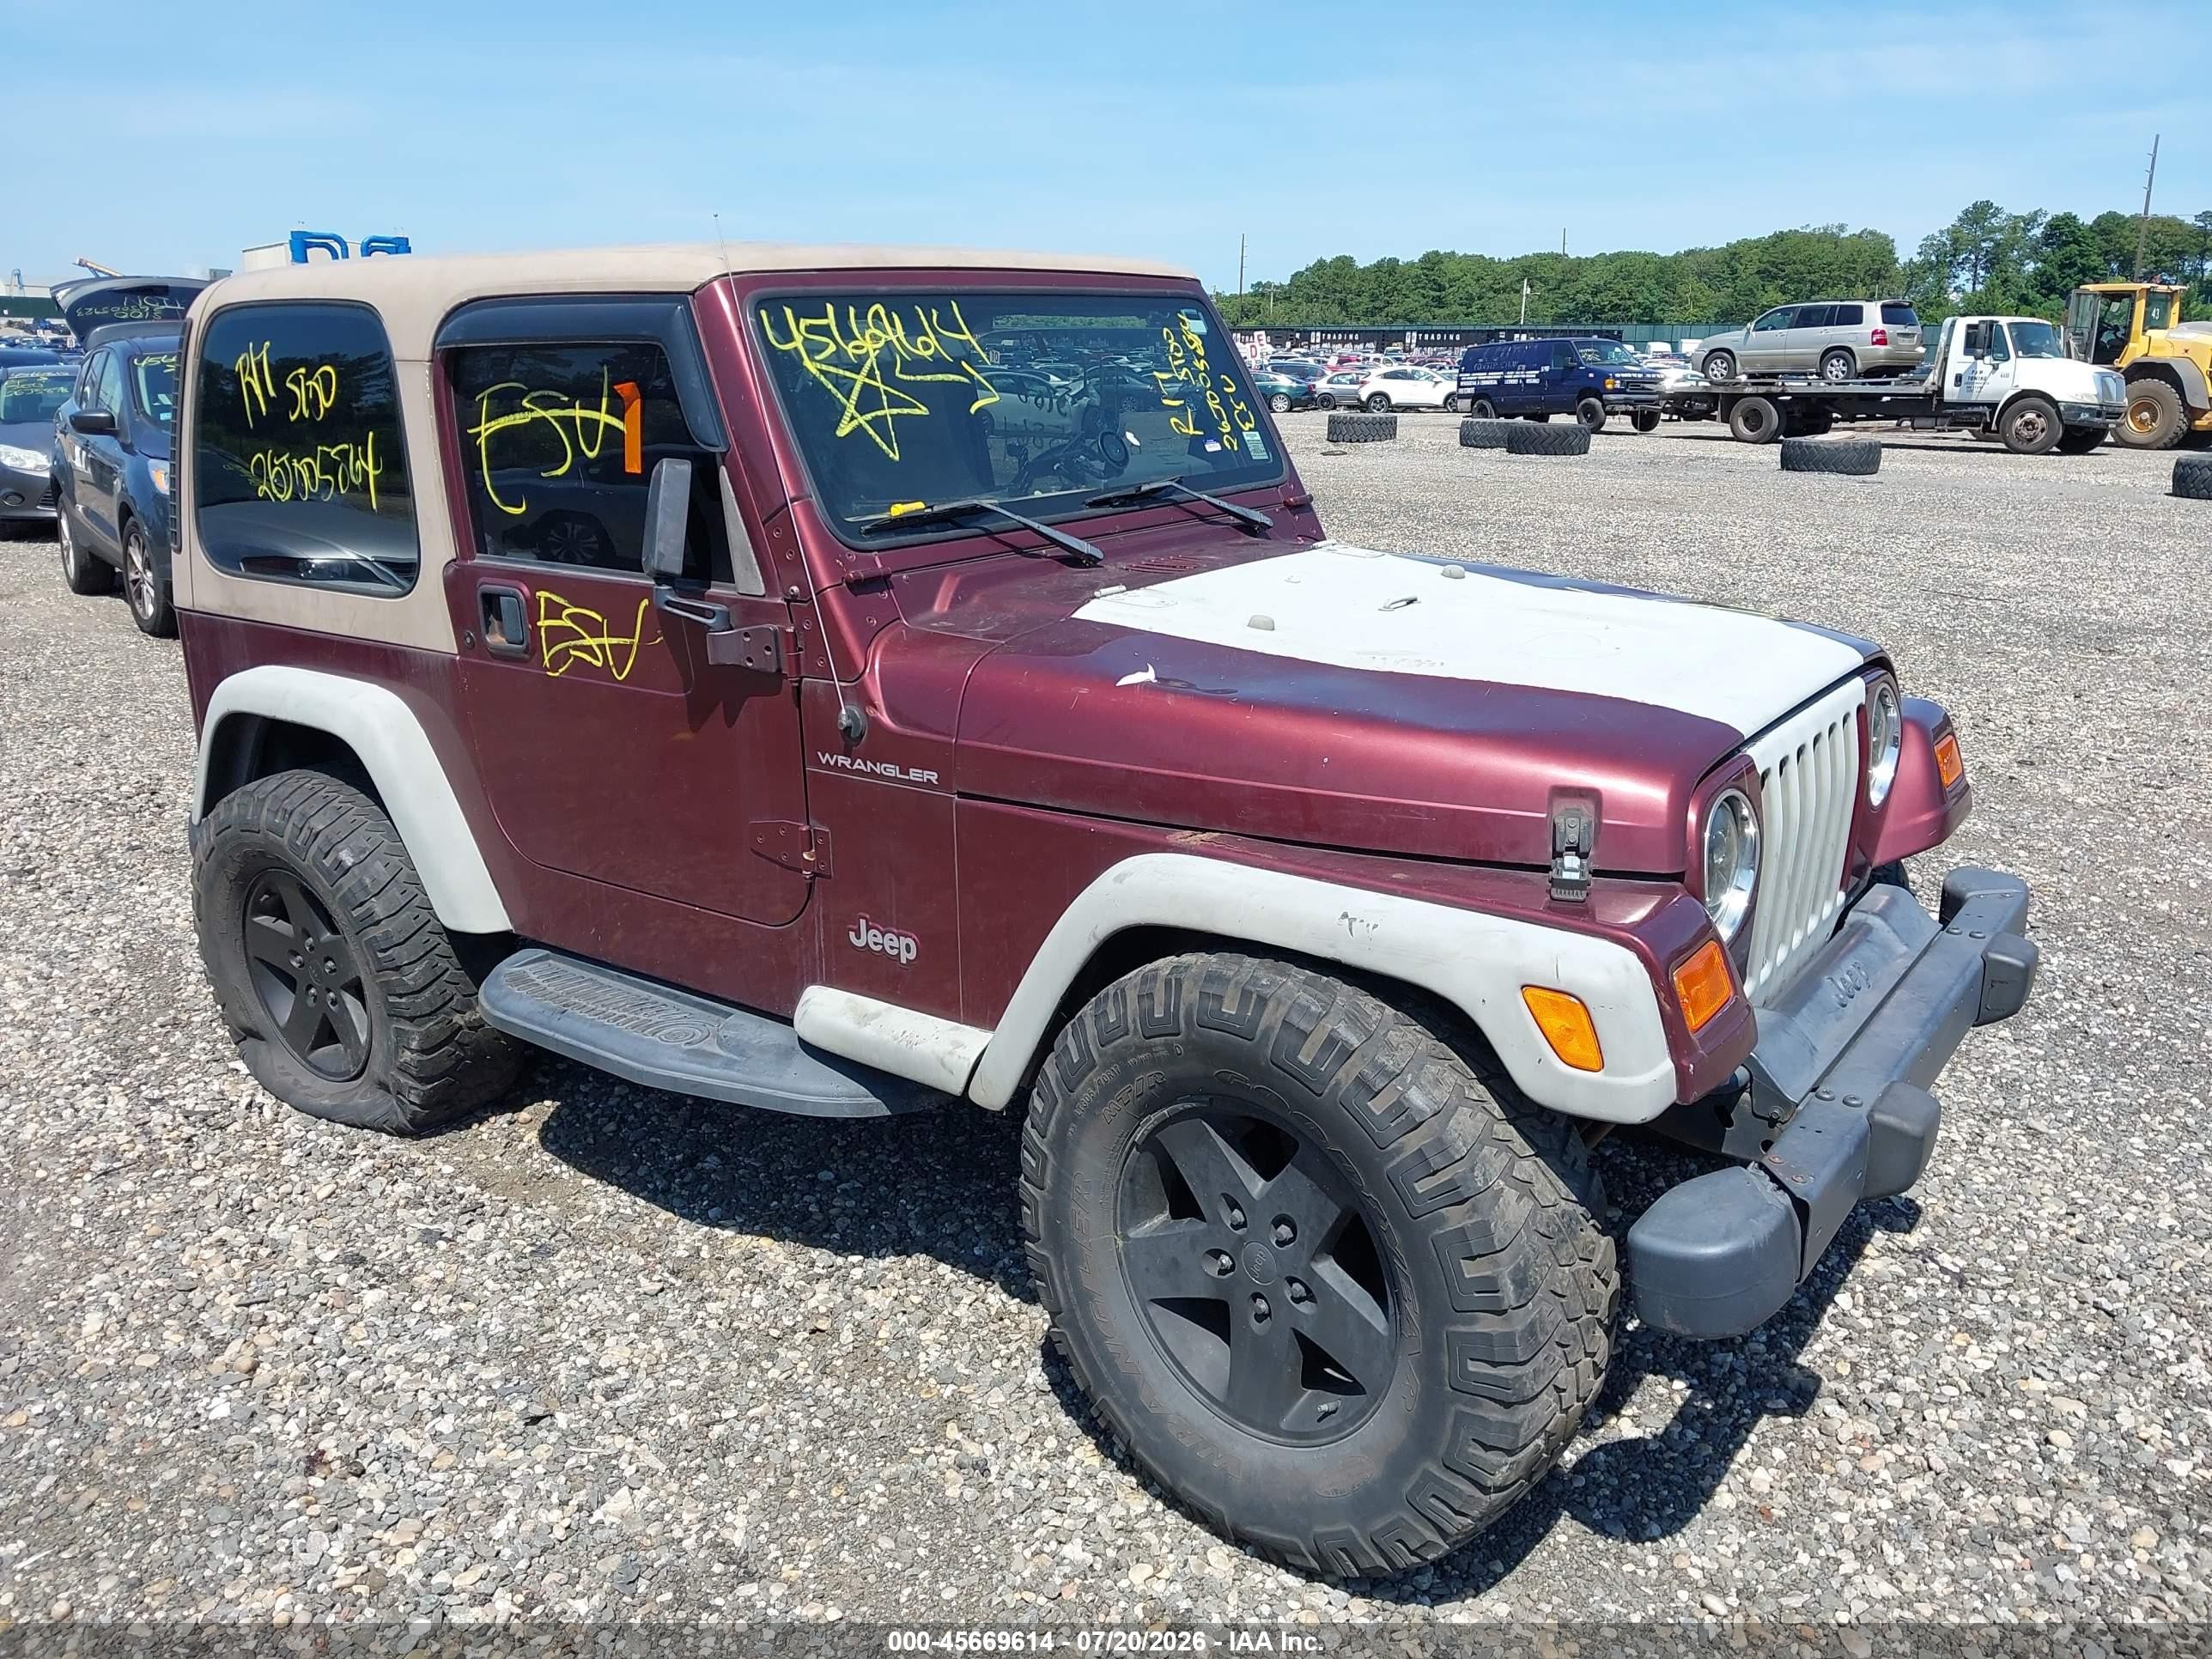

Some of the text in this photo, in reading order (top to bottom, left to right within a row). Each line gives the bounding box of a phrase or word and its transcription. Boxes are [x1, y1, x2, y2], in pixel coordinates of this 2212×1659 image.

[2151, 307, 2160, 320] 43
[1249, 344, 1258, 359] D
[1256, 334, 1265, 346] E
[817, 751, 939, 785] WRANGLER
[848, 919, 917, 964] Jeep
[1825, 962, 1872, 1008] Jeep
